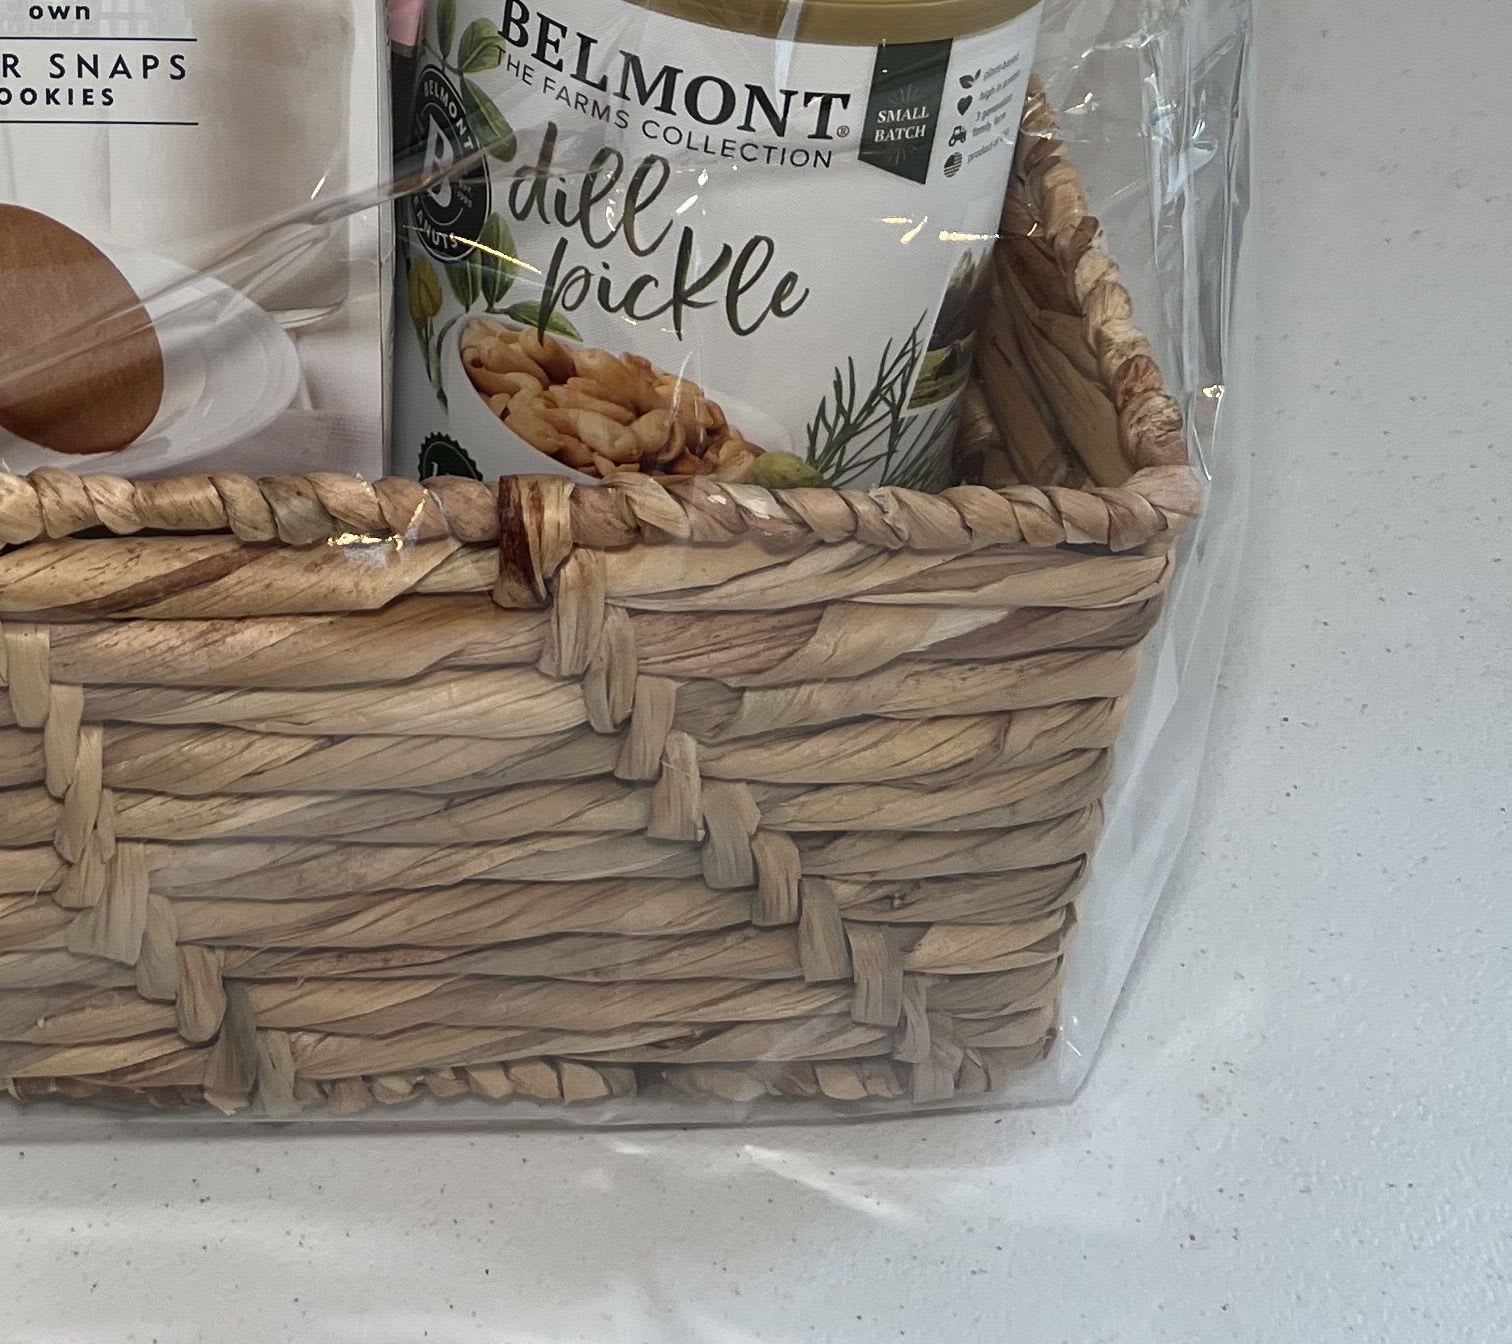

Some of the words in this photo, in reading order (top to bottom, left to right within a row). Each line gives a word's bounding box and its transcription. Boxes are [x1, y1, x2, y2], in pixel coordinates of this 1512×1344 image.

[29, 5, 91, 20] own
[49, 53, 187, 80] SNAPS
[423, 78, 474, 150] BELMONT
[497, 45, 536, 86] THE
[543, 78, 630, 129] FARMS
[641, 119, 833, 169] COLLECTION
[877, 106, 929, 123] SMALL
[874, 124, 926, 143] BATCH
[508, 121, 674, 257] dill
[538, 226, 810, 347] pickle
